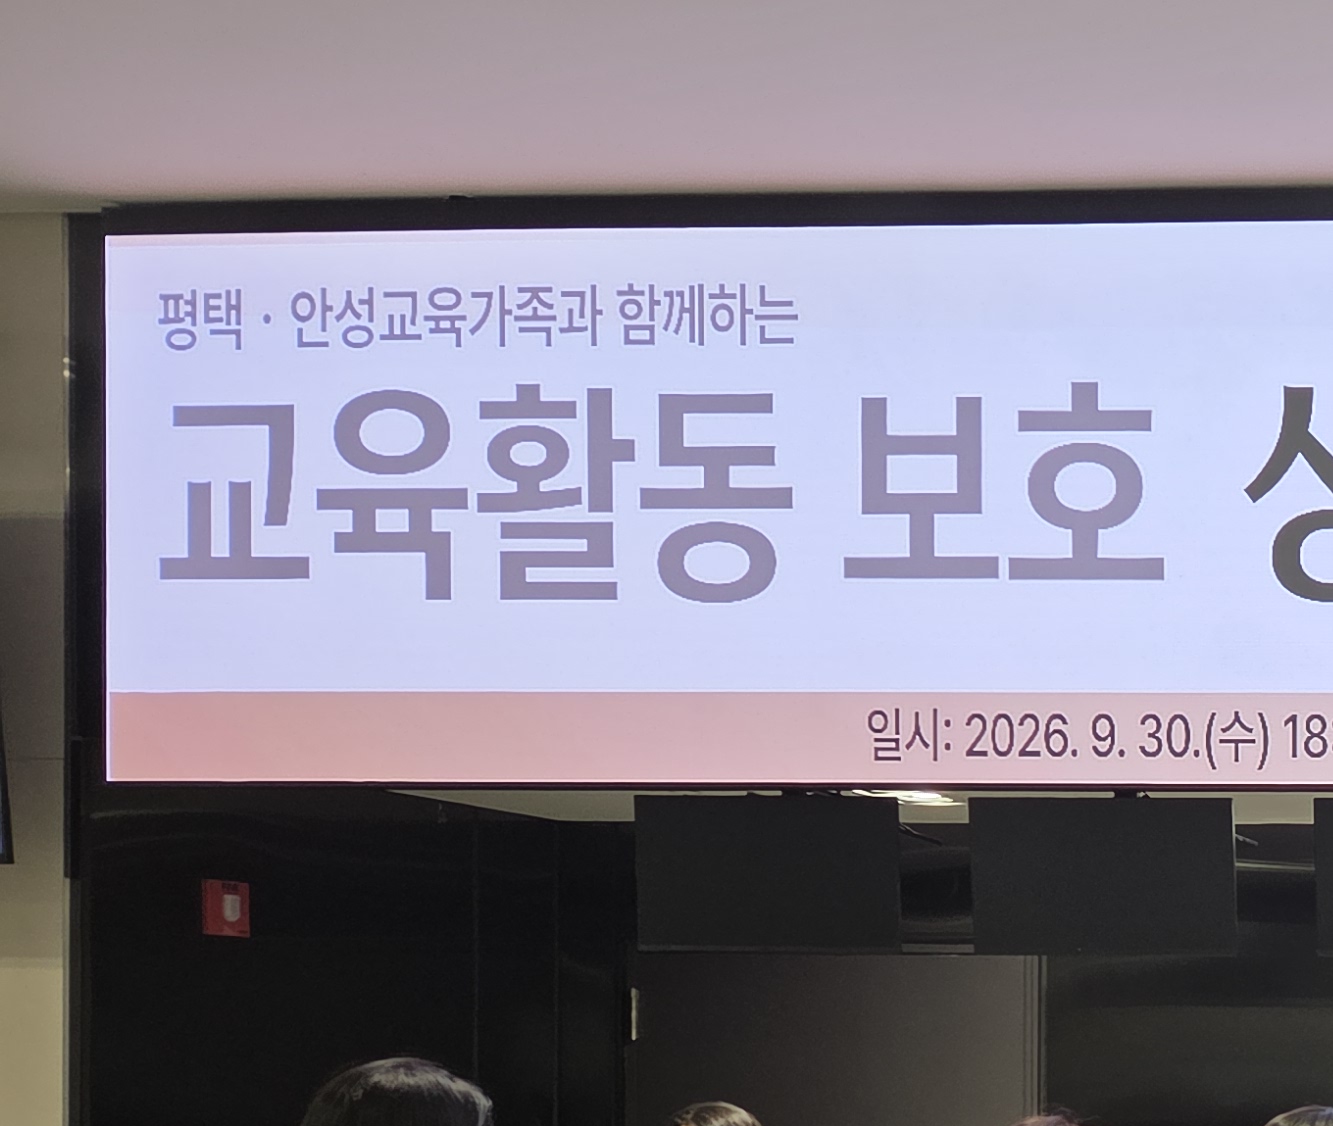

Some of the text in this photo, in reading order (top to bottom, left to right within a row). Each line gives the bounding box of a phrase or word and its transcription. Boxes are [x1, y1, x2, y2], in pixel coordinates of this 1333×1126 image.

[157, 288, 242, 351] 평택
[290, 284, 604, 349] 안성교육가족과
[616, 282, 799, 347] 함께하는
[158, 383, 794, 604] 교육활동
[843, 381, 1165, 581] 보호
[867, 707, 951, 762] 일시:
[965, 713, 1078, 758] 2026.
[1091, 713, 1126, 758] 9.
[1138, 710, 1269, 771] 30.(수)
